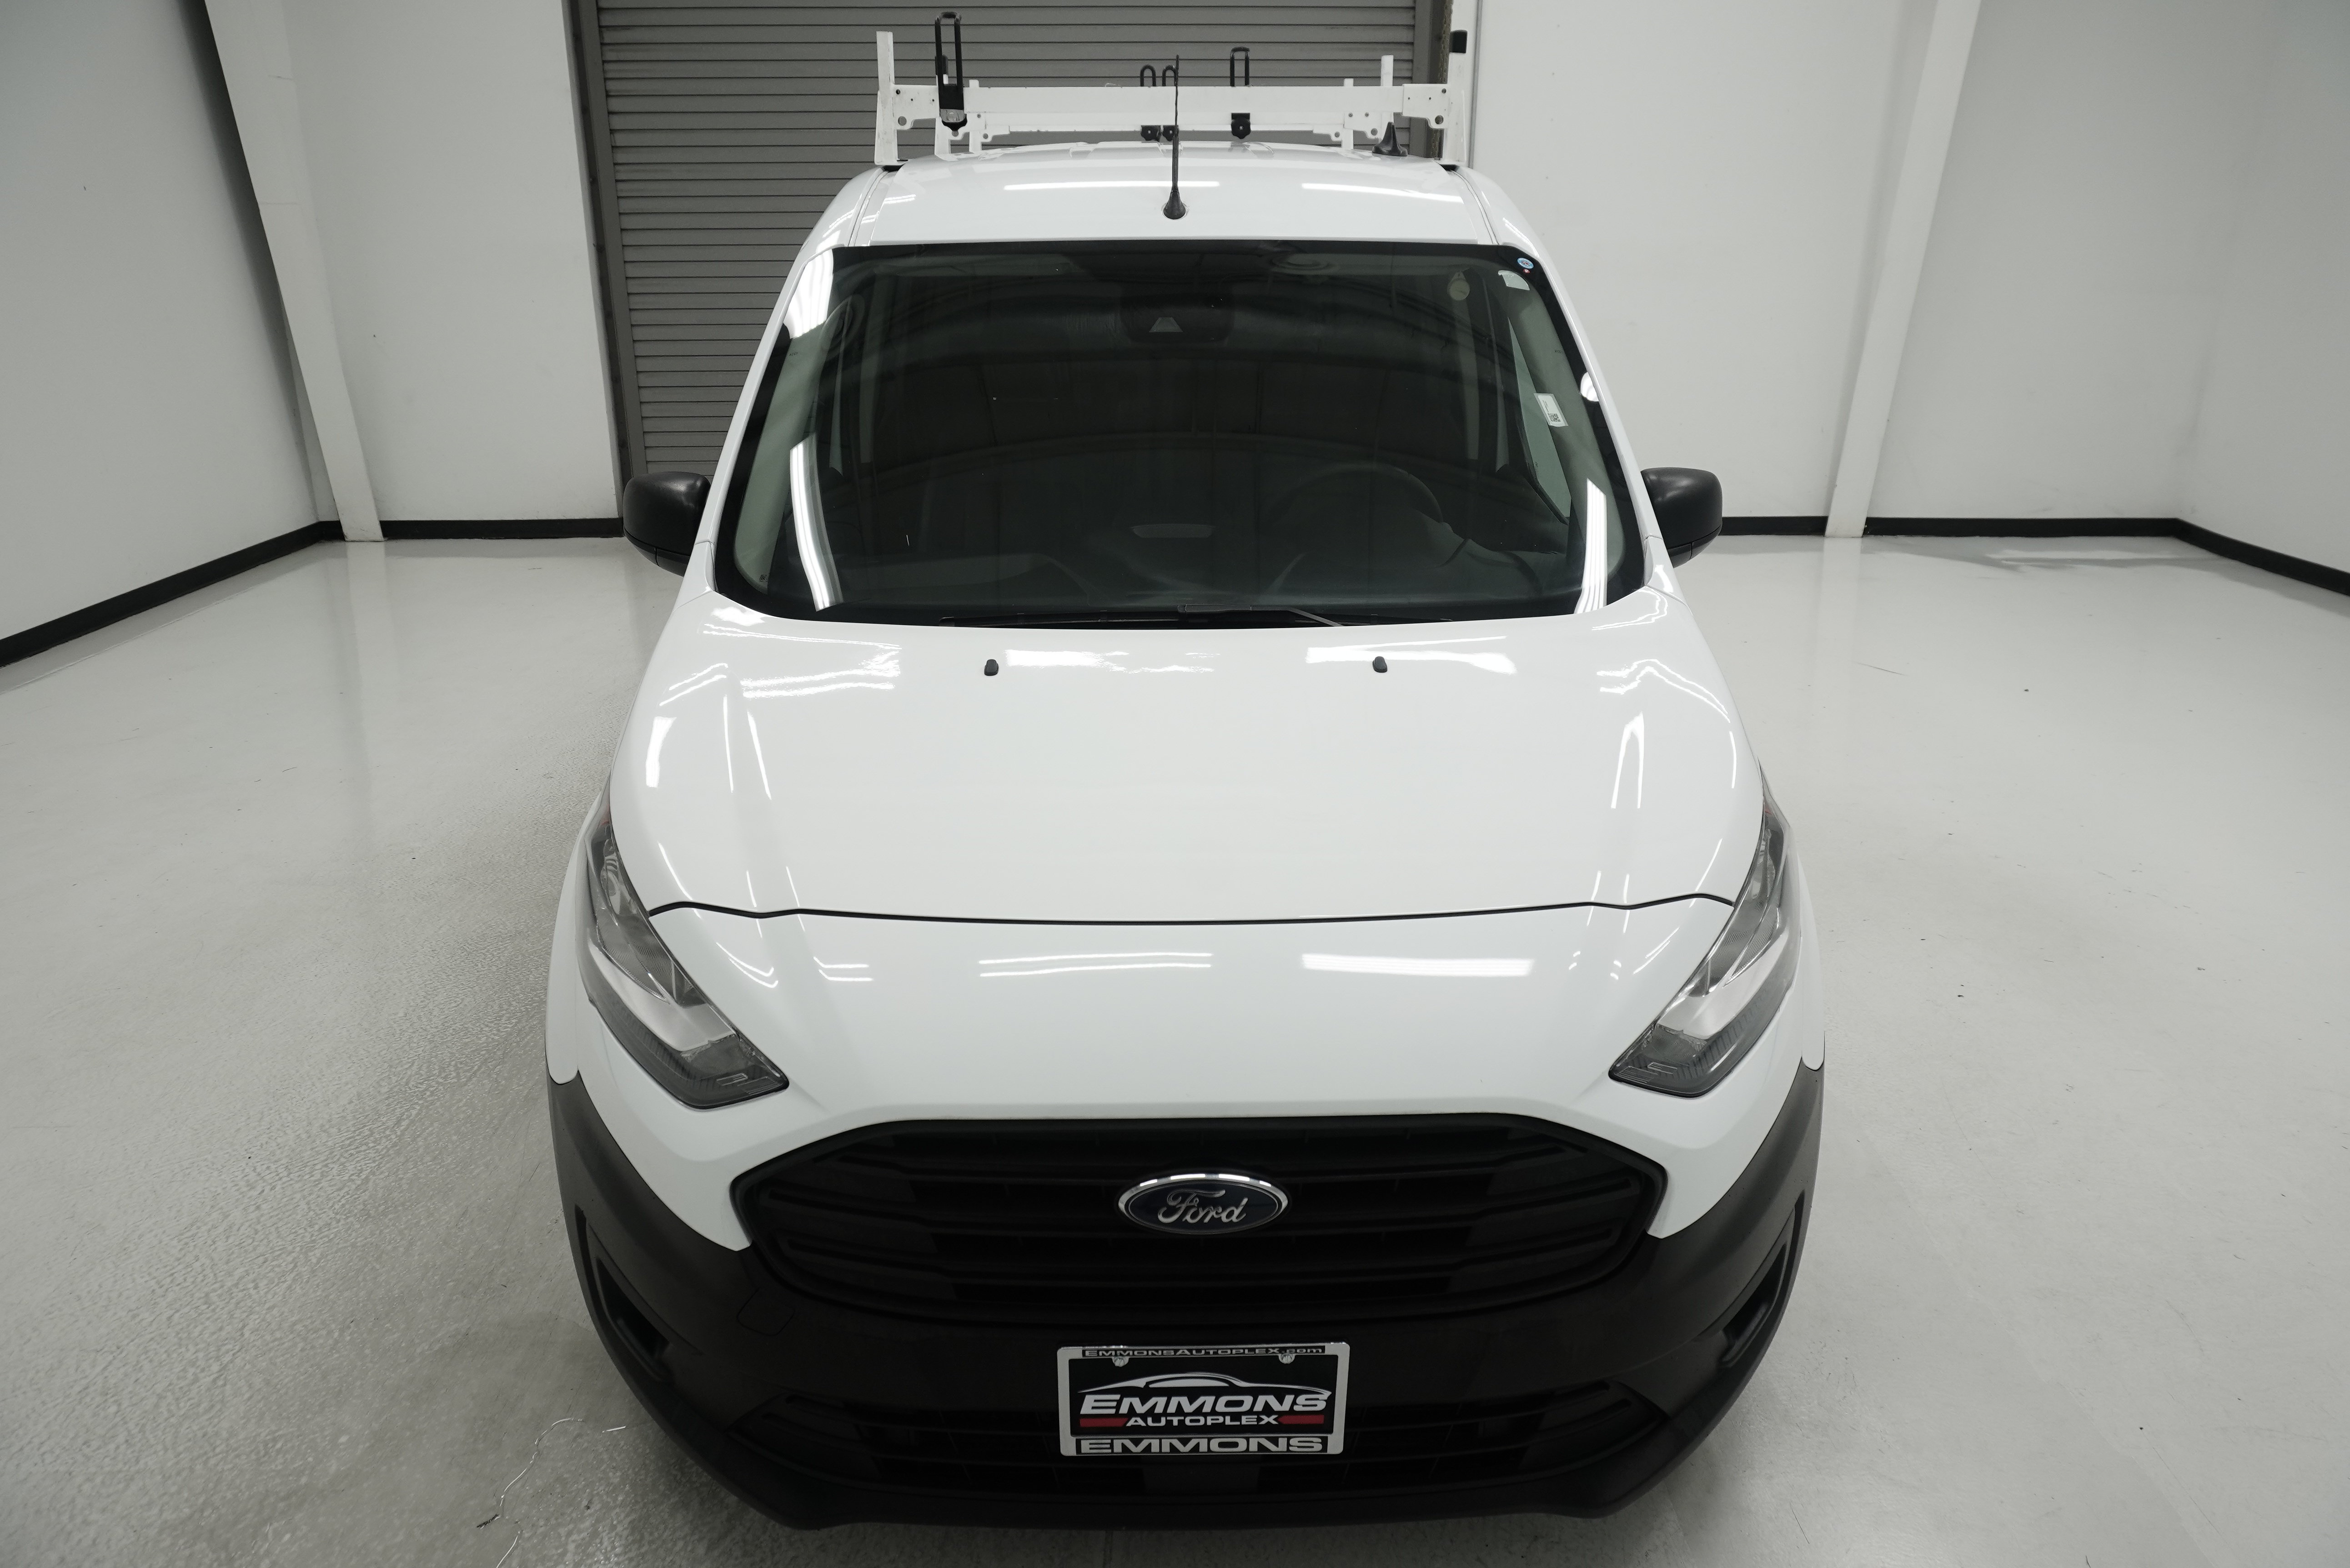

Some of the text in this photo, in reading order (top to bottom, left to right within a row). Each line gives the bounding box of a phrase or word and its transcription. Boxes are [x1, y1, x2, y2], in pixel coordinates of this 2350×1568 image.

[1157, 1189, 1249, 1224] Ford
[1080, 1394, 1328, 1414] EMMONS
[1126, 1415, 1279, 1427] AUTOPLEX
[1080, 1437, 1322, 1453] EMMONS
